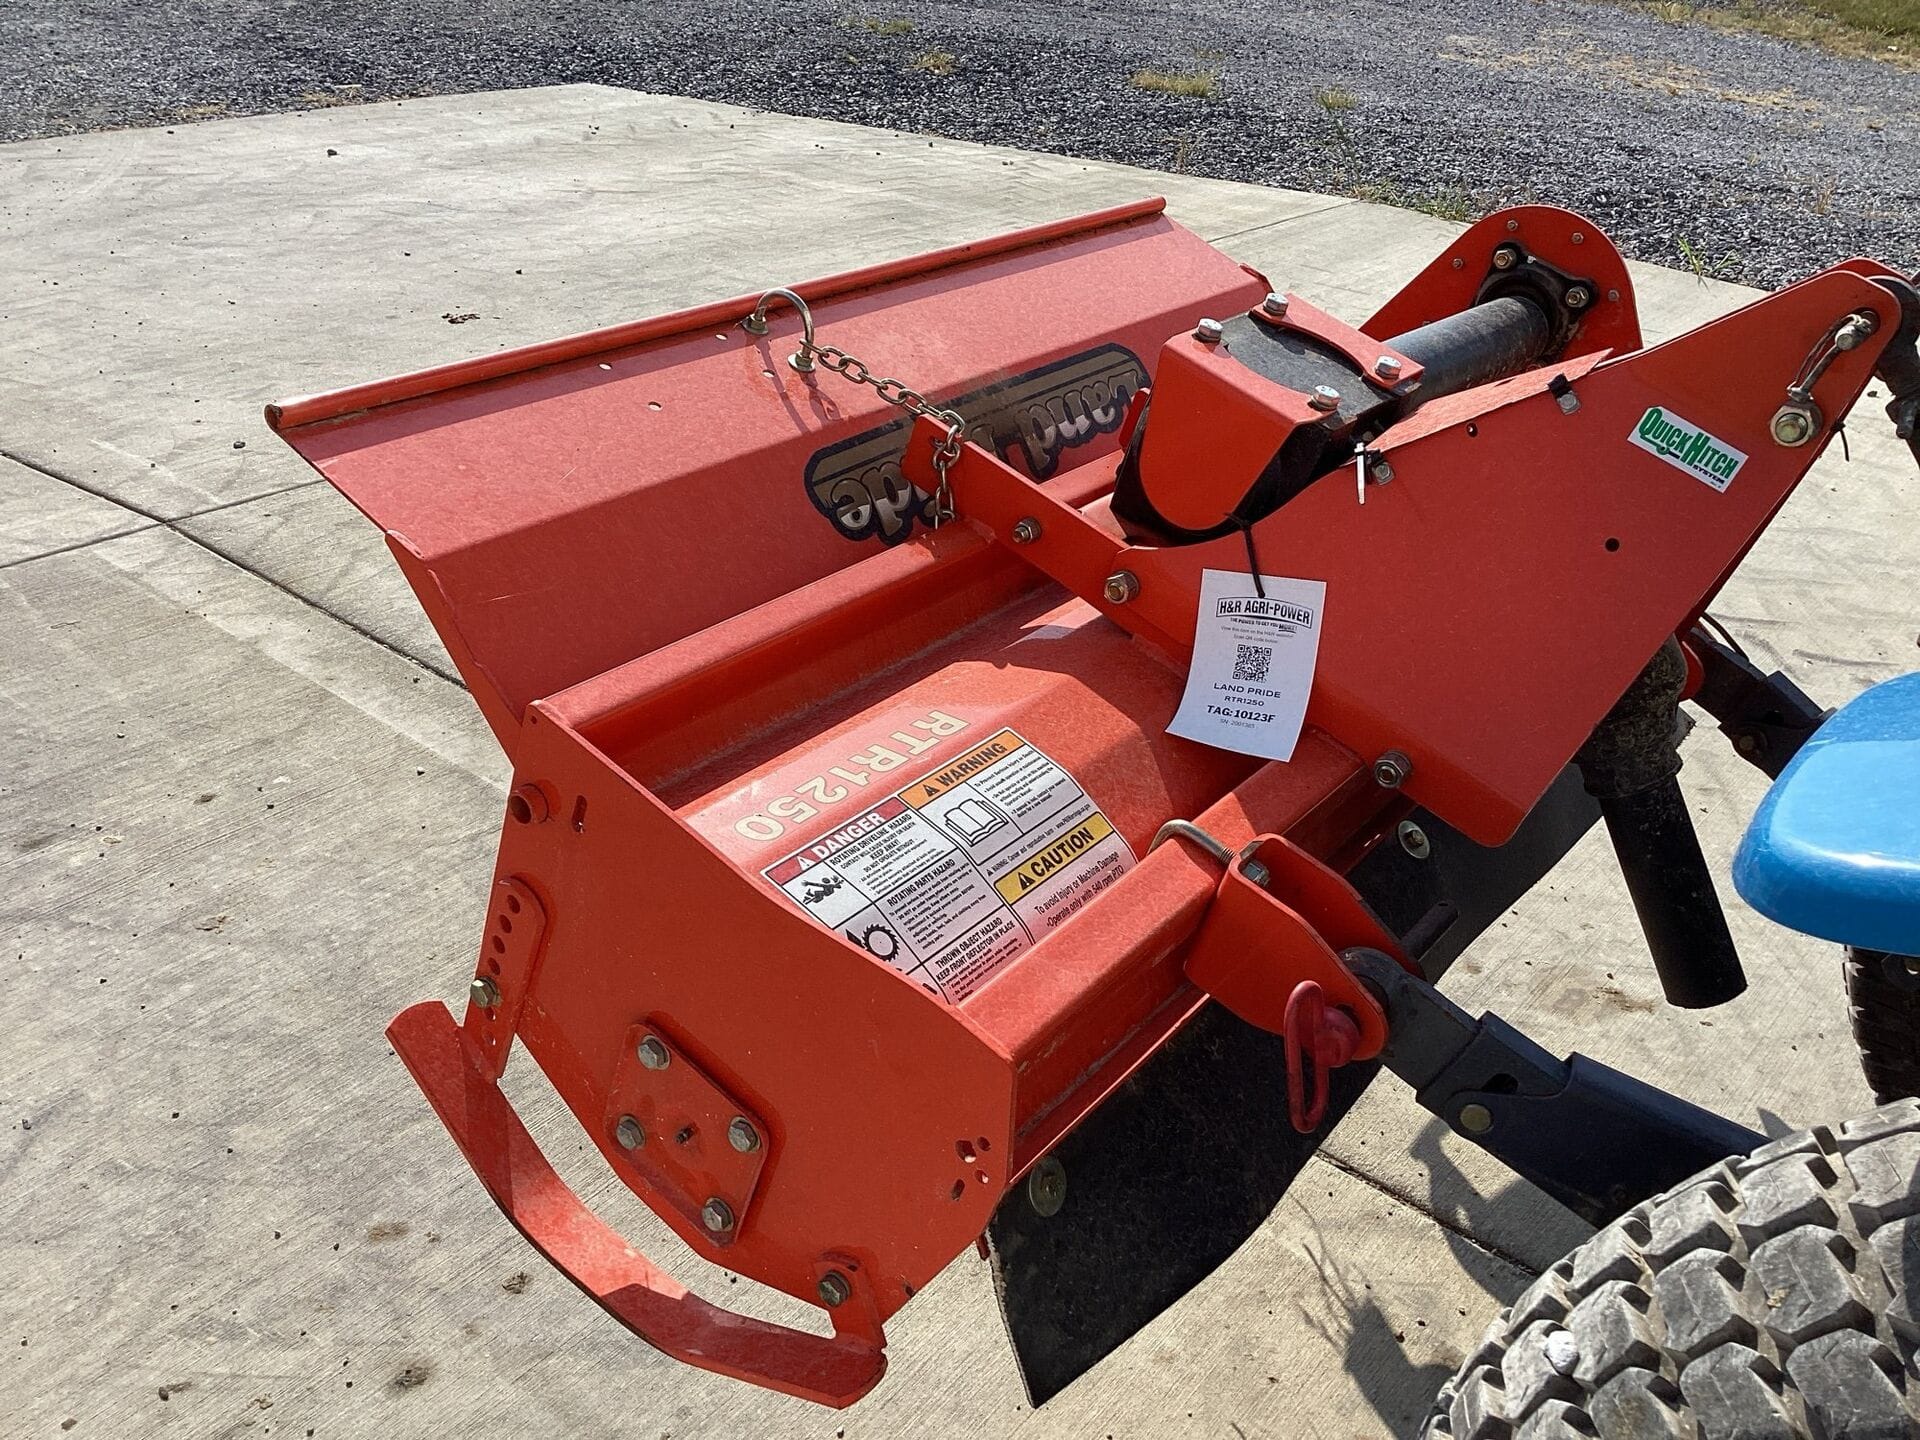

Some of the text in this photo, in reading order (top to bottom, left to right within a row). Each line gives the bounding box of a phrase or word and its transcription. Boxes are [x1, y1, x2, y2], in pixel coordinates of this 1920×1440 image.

[1012, 367, 1139, 473] Land
[1693, 464, 1725, 484] SYSTEM
[1219, 600, 1309, 624] H&R AGRI-POWER
[1214, 682, 1280, 698] LAND PRIDE
[1224, 695, 1264, 706] RTR1250
[734, 708, 970, 842] RTR1250
[938, 743, 1007, 787] WARNING
[812, 811, 886, 860] DANGER
[829, 845, 860, 865] ROTATING
[857, 827, 889, 848] DRIVELINE
[887, 814, 912, 830] HAZARD
[870, 848, 883, 860] KEEP
[1031, 827, 1094, 877] CAUTION
[886, 884, 917, 906] ROTATING
[914, 872, 934, 888] PARTS
[931, 859, 955, 877] HAZARD
[1034, 851, 1119, 915] To avoid Injury or Machine Damage
[1068, 897, 1084, 913] only
[1079, 888, 1094, 902] with
[1090, 880, 1103, 894] 540
[1099, 873, 1116, 888] rpm
[1109, 864, 1125, 879] PTO
[935, 917, 1002, 968] THROWN OBJECT HAZARD
[936, 967, 950, 982] KEEP
[949, 955, 967, 972] FRONT
[965, 936, 994, 960] DEFLECTOR
[998, 920, 1015, 935] PLACE
